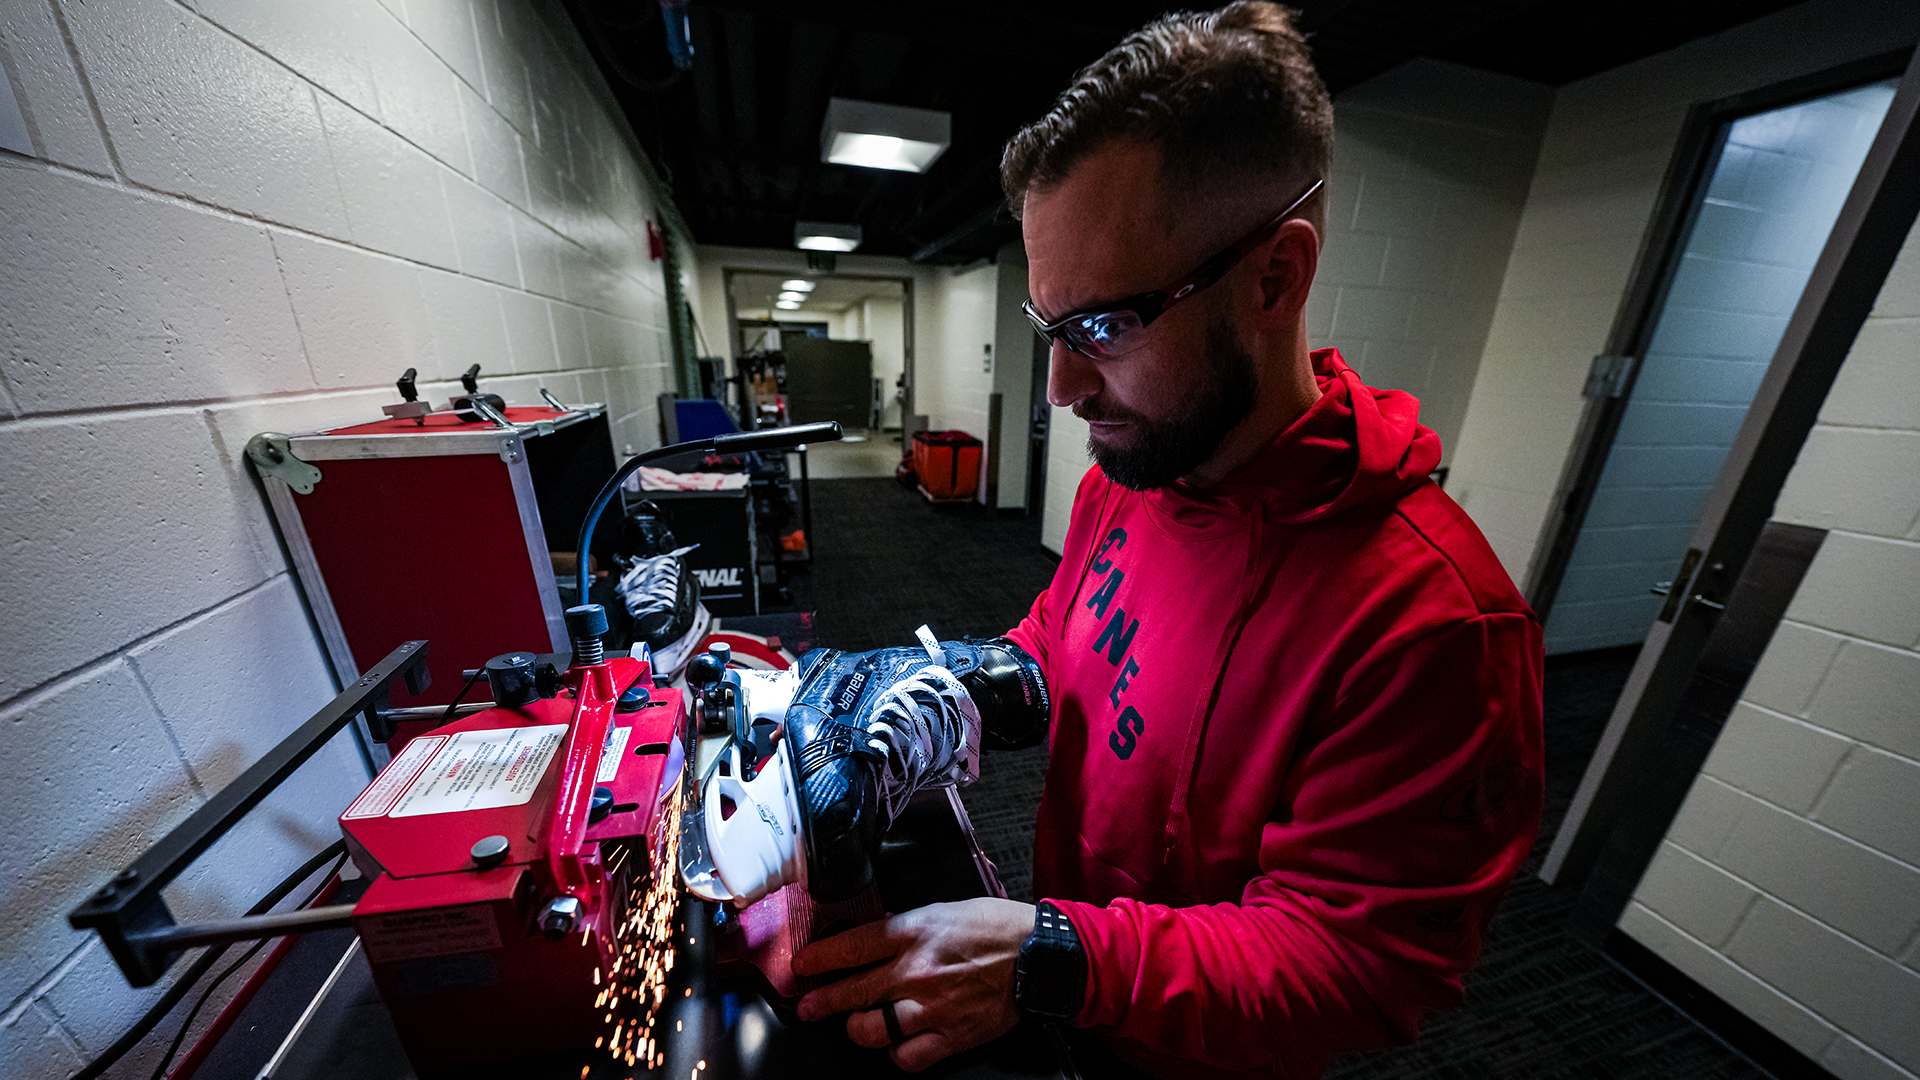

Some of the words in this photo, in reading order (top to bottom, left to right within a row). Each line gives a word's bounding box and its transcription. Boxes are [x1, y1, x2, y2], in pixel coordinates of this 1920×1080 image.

[692, 567, 743, 588] NAL
[1086, 527, 1145, 761] CANES
[837, 672, 866, 711] BAUER
[1032, 669, 1049, 705] BAUER
